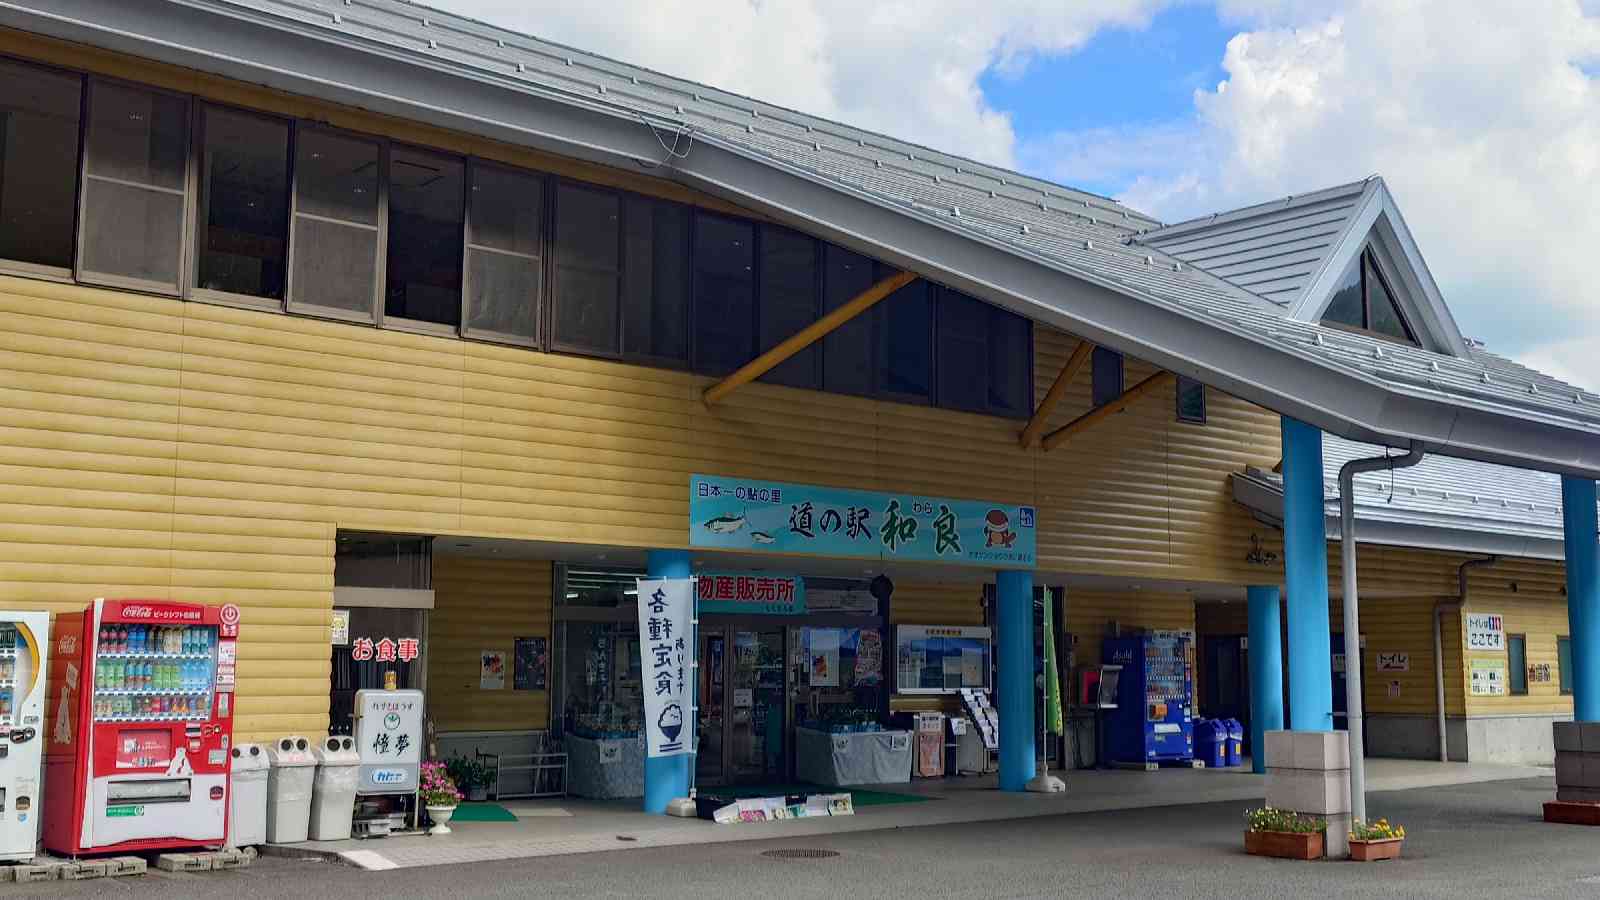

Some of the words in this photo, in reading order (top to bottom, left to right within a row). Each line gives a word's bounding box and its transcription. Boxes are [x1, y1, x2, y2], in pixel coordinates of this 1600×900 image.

[698, 483, 782, 504] 日本一の鮎の里
[912, 500, 932, 514] わら
[789, 503, 872, 540] 道の駅
[880, 500, 962, 554] 和良
[698, 576, 795, 602] 物産販売所
[352, 637, 419, 662] お食事
[647, 587, 674, 697] 各種定食
[1471, 633, 1501, 647] ここです
